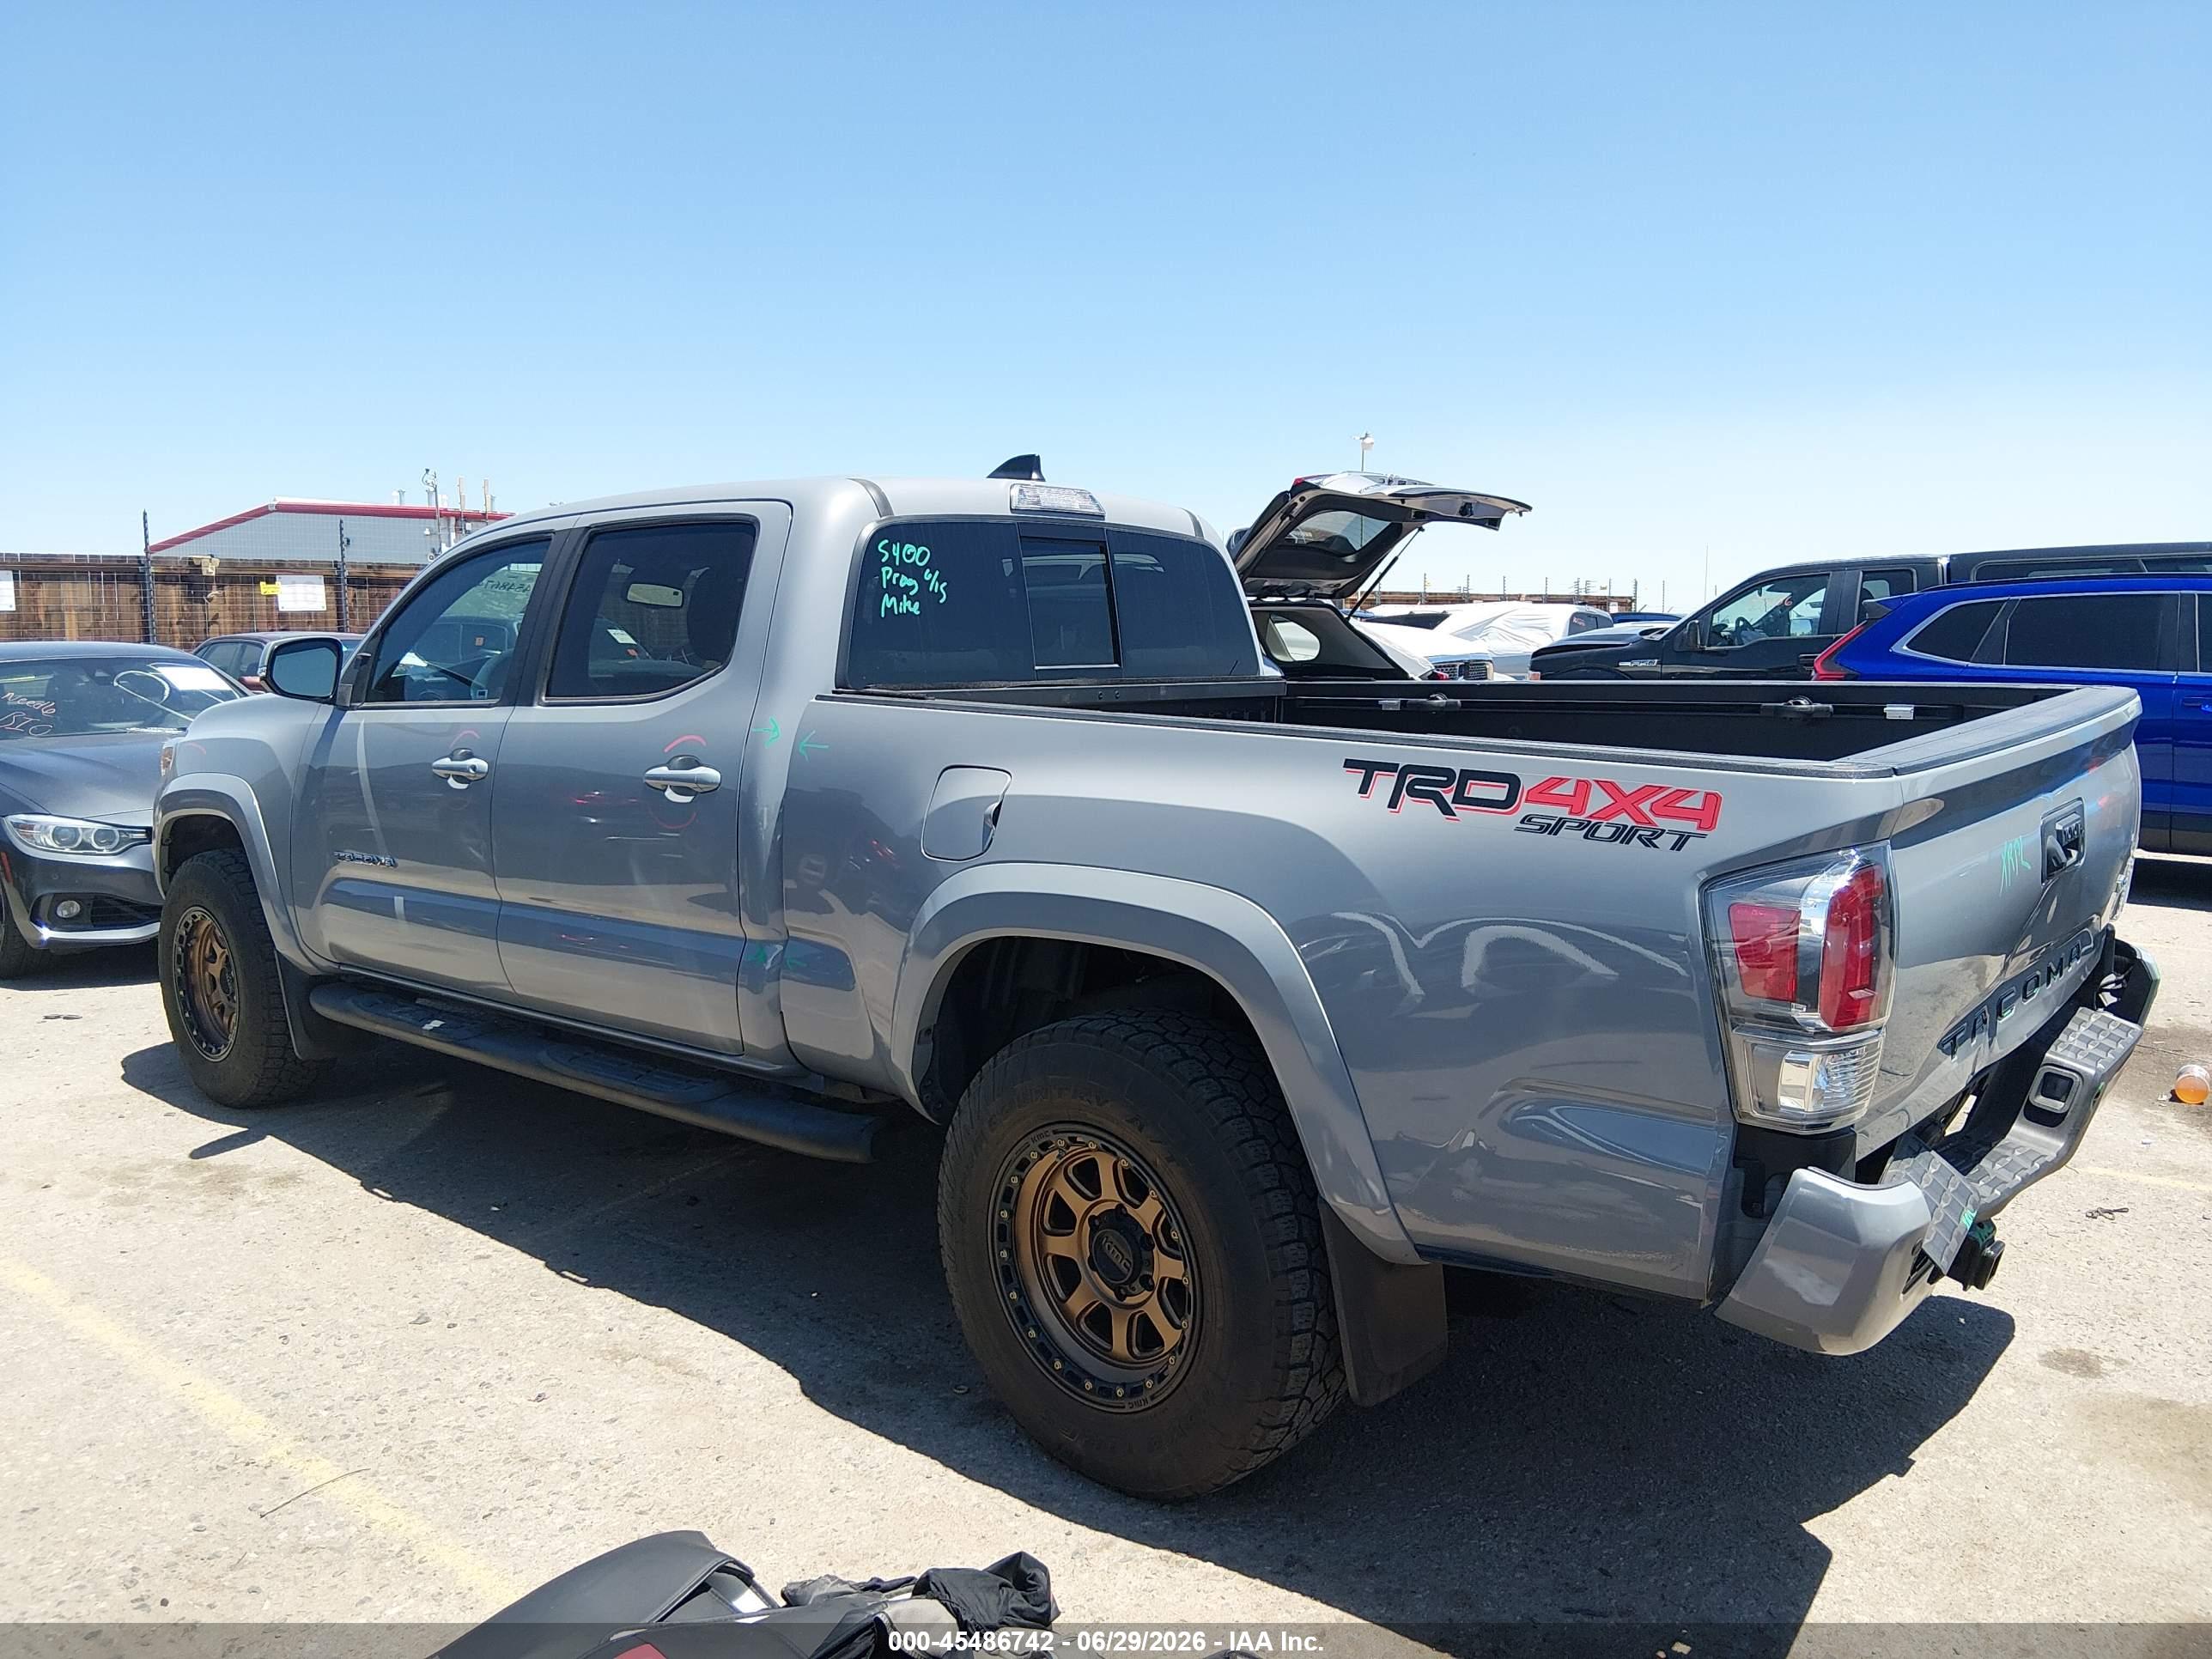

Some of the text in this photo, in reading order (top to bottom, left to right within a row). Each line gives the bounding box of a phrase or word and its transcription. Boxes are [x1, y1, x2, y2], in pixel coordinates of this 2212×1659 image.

[880, 592, 921, 618] Mike
[1342, 758, 1525, 822] TRD
[1514, 814, 1707, 852] SPORT
[1942, 939, 2082, 1062] TACOMA
